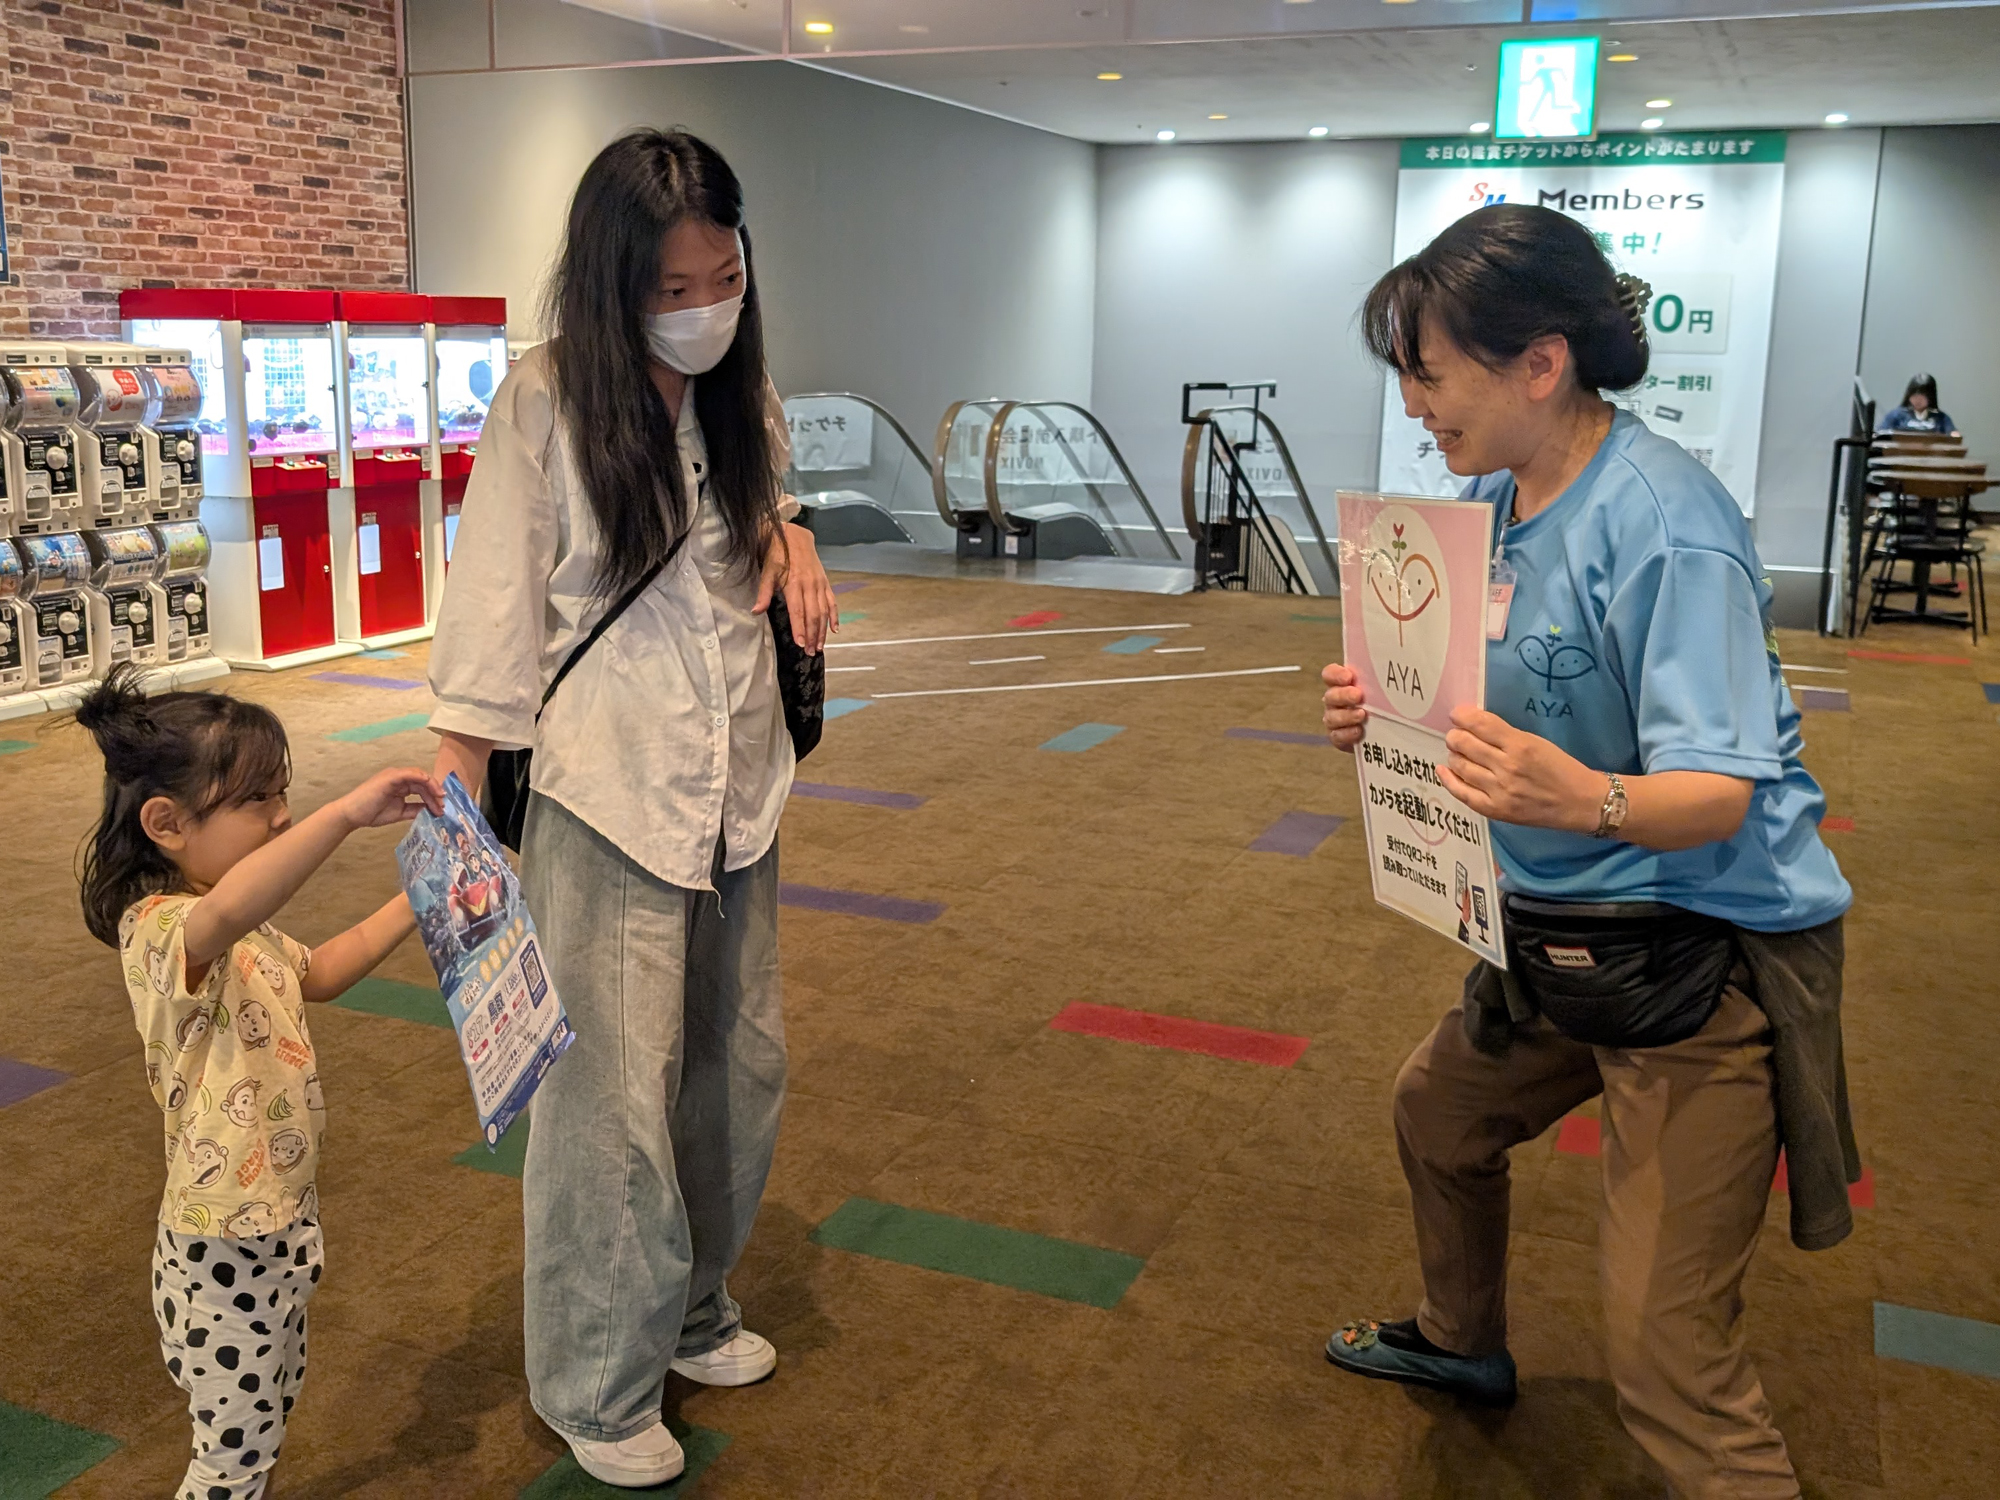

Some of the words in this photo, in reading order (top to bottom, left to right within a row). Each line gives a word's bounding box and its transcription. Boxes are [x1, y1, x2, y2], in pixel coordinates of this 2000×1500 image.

[1537, 188, 1705, 211] Members
[1386, 660, 1424, 701] AYA
[1525, 697, 1574, 719] AYA
[1369, 782, 1481, 847] カメラを起動してください
[1386, 834, 1438, 871] 受付でQRコードを
[1382, 854, 1448, 898] 読み取っていただきます
[1550, 953, 1589, 963] HUNTER
